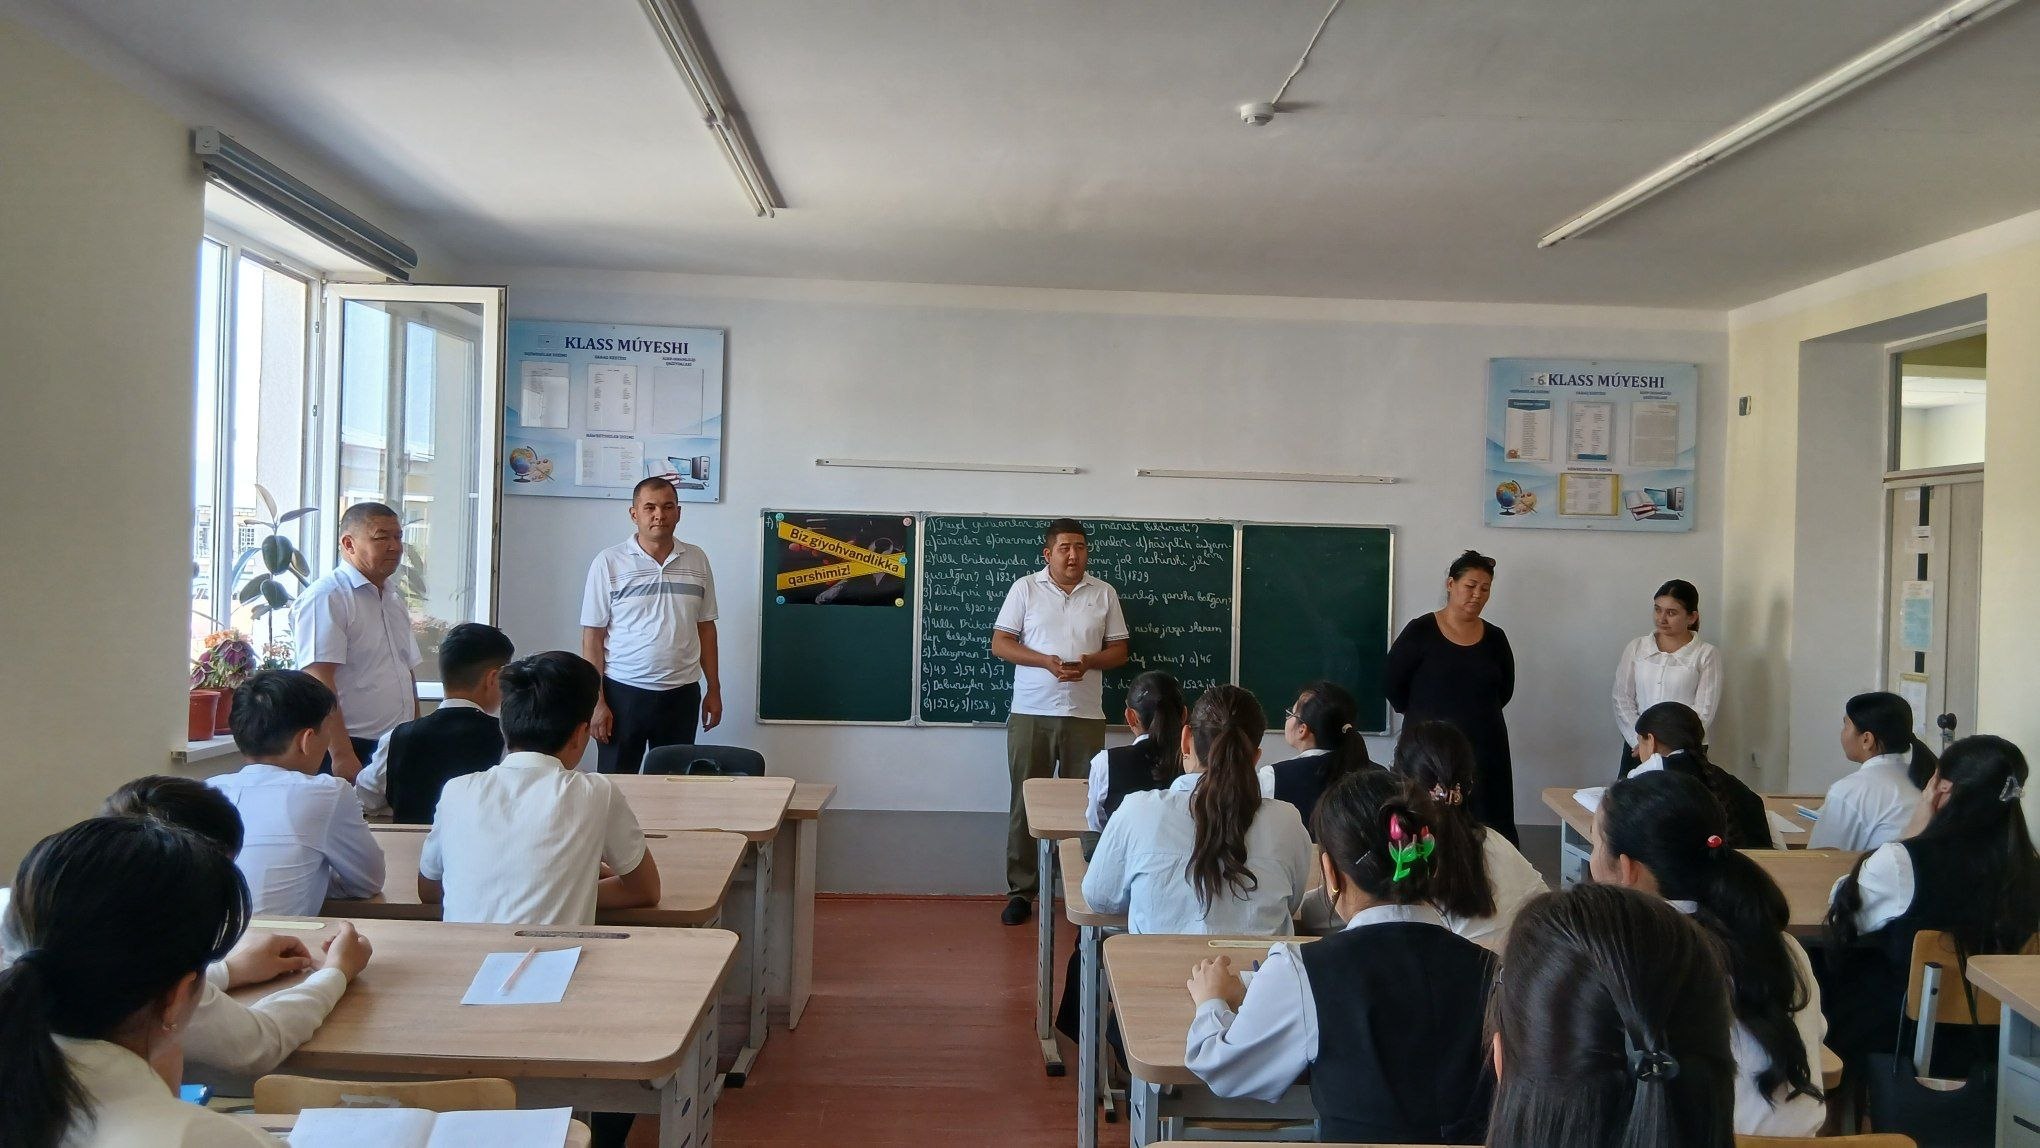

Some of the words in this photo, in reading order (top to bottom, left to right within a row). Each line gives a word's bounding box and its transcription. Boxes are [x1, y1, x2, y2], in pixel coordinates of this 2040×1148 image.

[565, 336, 614, 351] KLASS
[617, 336, 689, 355] MÚYESHI
[1548, 373, 1594, 387] KLASS
[1597, 371, 1665, 389] MÚYESHI
[790, 528, 809, 543] Biz
[809, 536, 900, 573] giyohvandlikka
[788, 564, 851, 586] qarshimiz!
